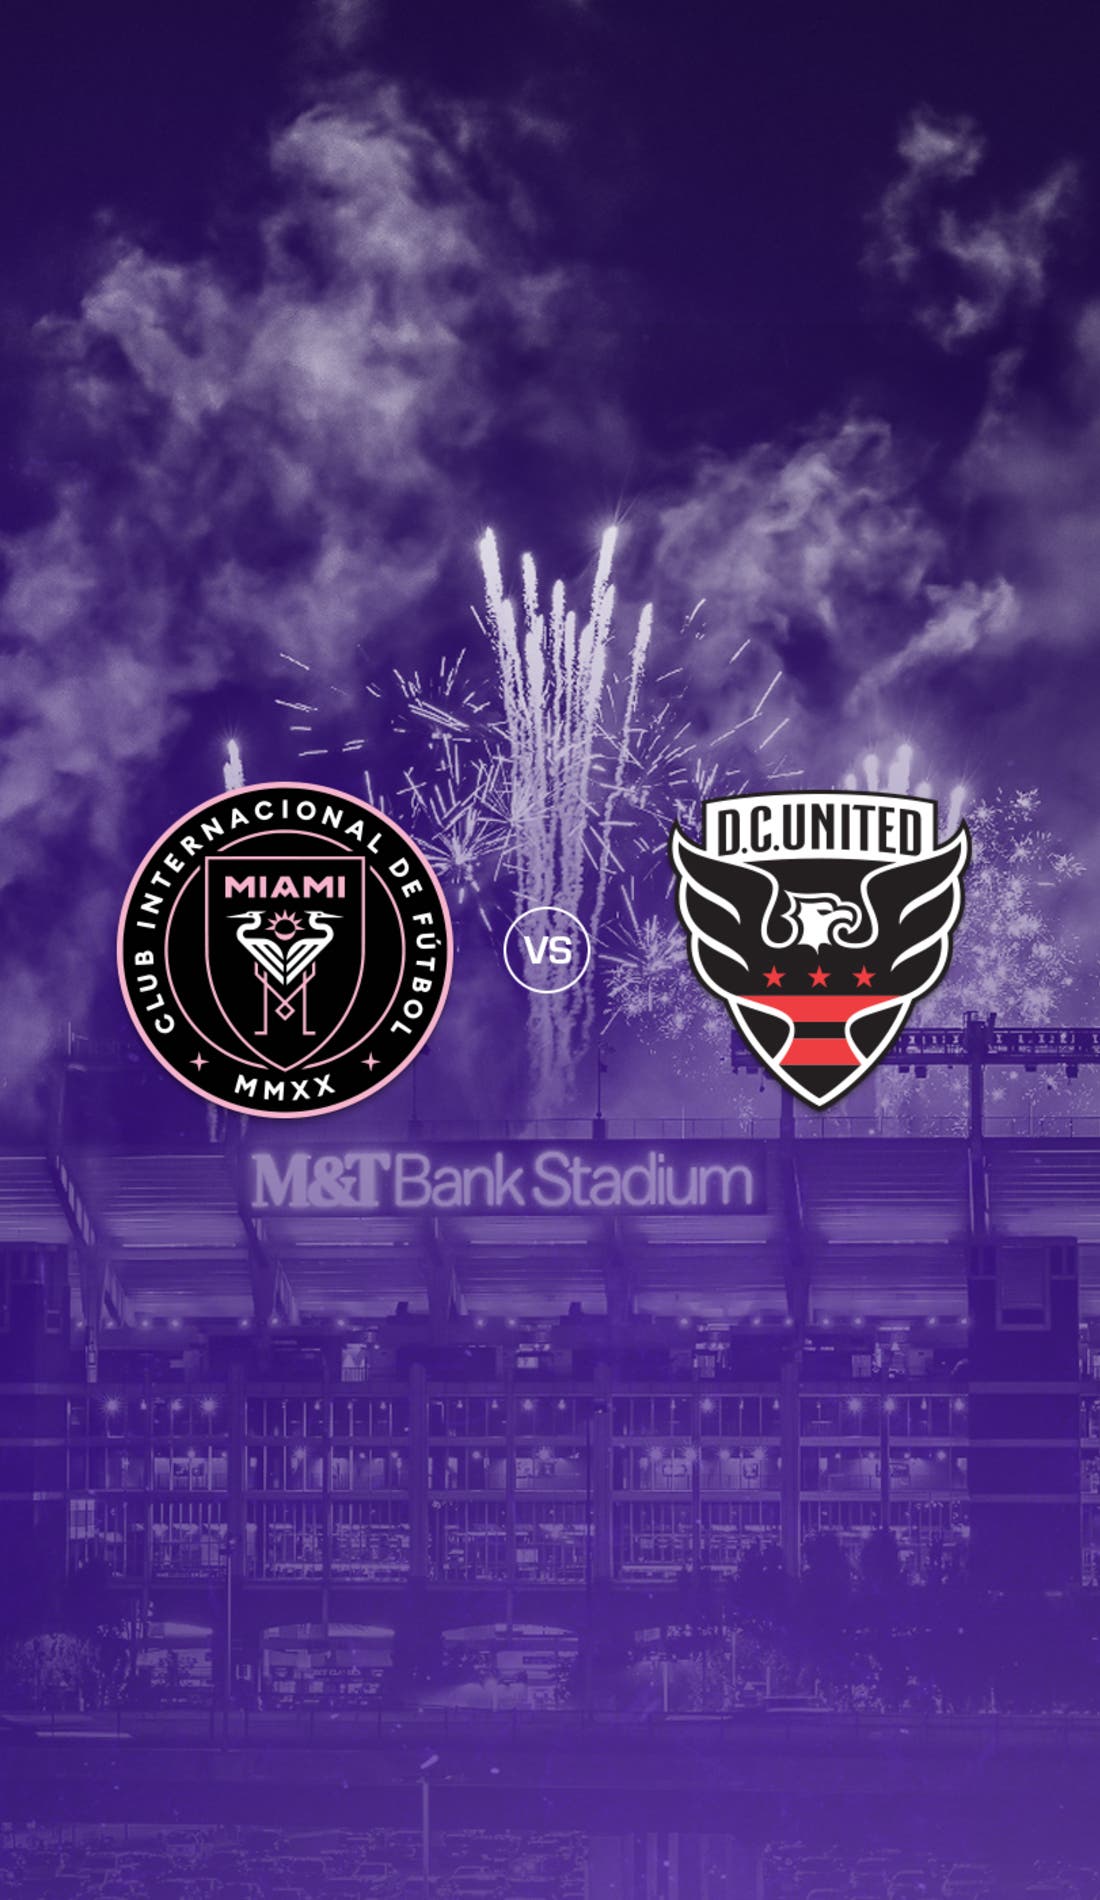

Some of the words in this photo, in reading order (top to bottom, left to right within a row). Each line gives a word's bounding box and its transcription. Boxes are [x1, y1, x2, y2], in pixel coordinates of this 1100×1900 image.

[251, 1152, 390, 1209] M&T
[395, 1152, 526, 1207] Bank
[533, 1150, 753, 1207] Stadium
